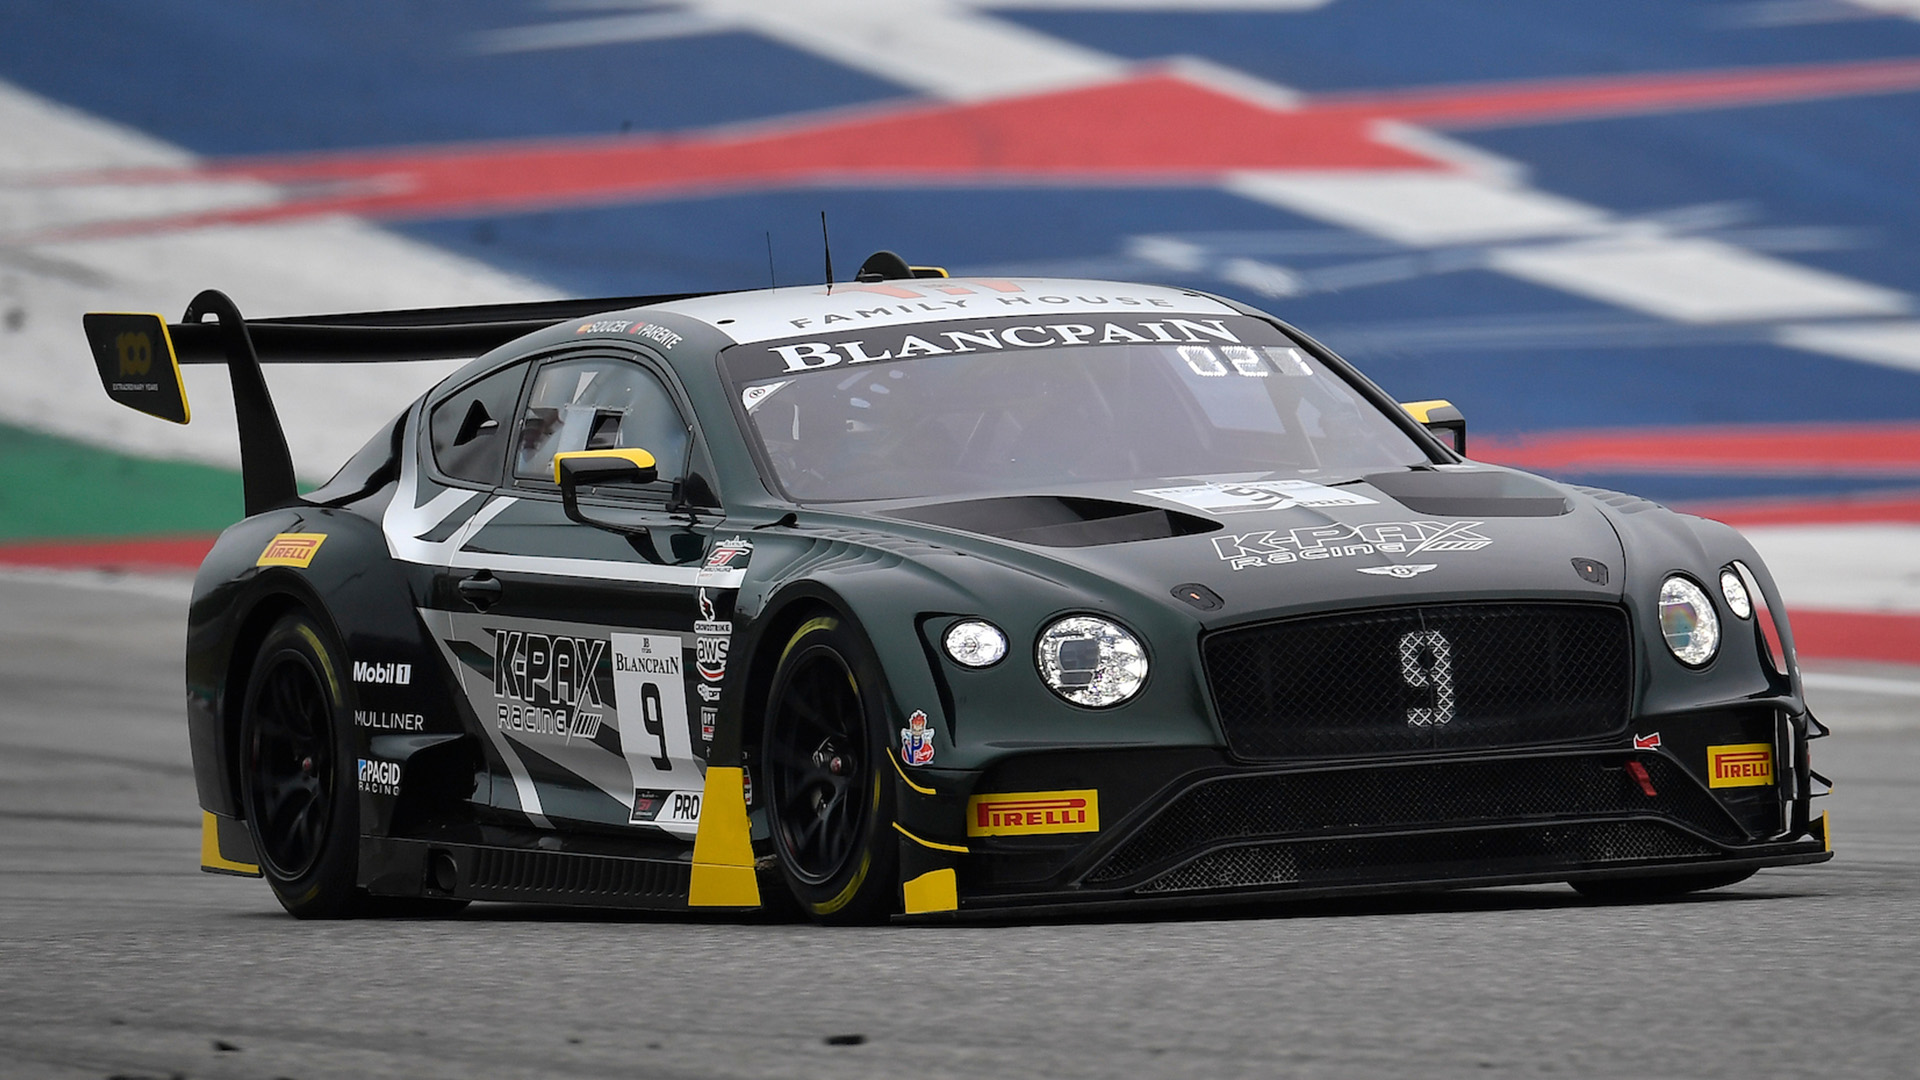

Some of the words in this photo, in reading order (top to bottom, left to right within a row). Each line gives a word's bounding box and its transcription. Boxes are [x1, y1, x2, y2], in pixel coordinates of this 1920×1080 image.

[789, 299, 967, 329] FAMILY
[997, 294, 1174, 308] HOUSE
[637, 323, 683, 350] PARENTE
[767, 317, 1242, 374] BLANCPAIN
[264, 539, 318, 560] PIRELLI
[1211, 521, 1492, 561] K-PAX
[615, 652, 679, 675] BLANCPAIN
[697, 639, 729, 661] aws
[353, 661, 395, 684] Mobil
[395, 664, 412, 685] 1
[494, 630, 605, 708] K-PAX
[1399, 630, 1456, 728] 9
[354, 709, 424, 731] MULLINER
[641, 682, 672, 772] 9
[366, 760, 400, 786] PAGID
[1714, 751, 1770, 779] PIRELLI
[358, 781, 400, 796] RACING
[673, 794, 701, 820] PRO
[976, 798, 1087, 828] PIRELLI
